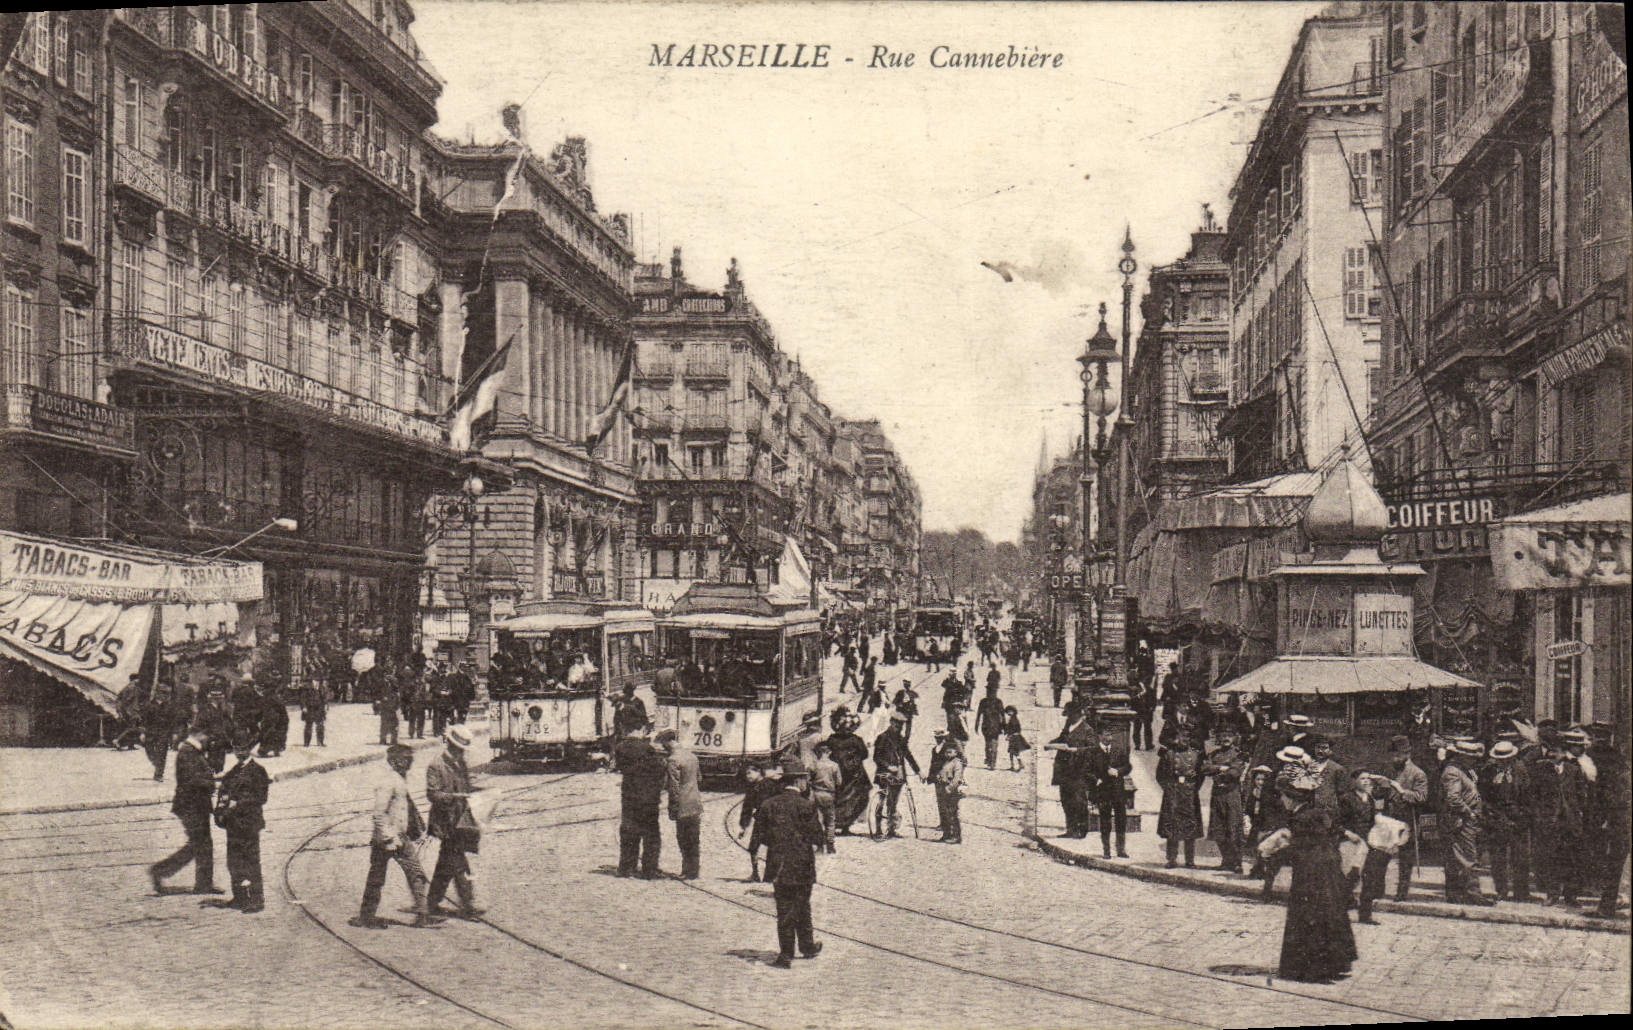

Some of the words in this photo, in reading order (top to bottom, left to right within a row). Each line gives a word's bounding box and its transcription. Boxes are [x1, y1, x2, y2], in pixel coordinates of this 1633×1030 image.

[1385, 499, 1494, 529] COIFFEUR
[651, 523, 713, 535] GRAND
[1360, 611, 1409, 629] LUNETTES
[0, 612, 123, 668] ABACS
[694, 733, 722, 747] 708
